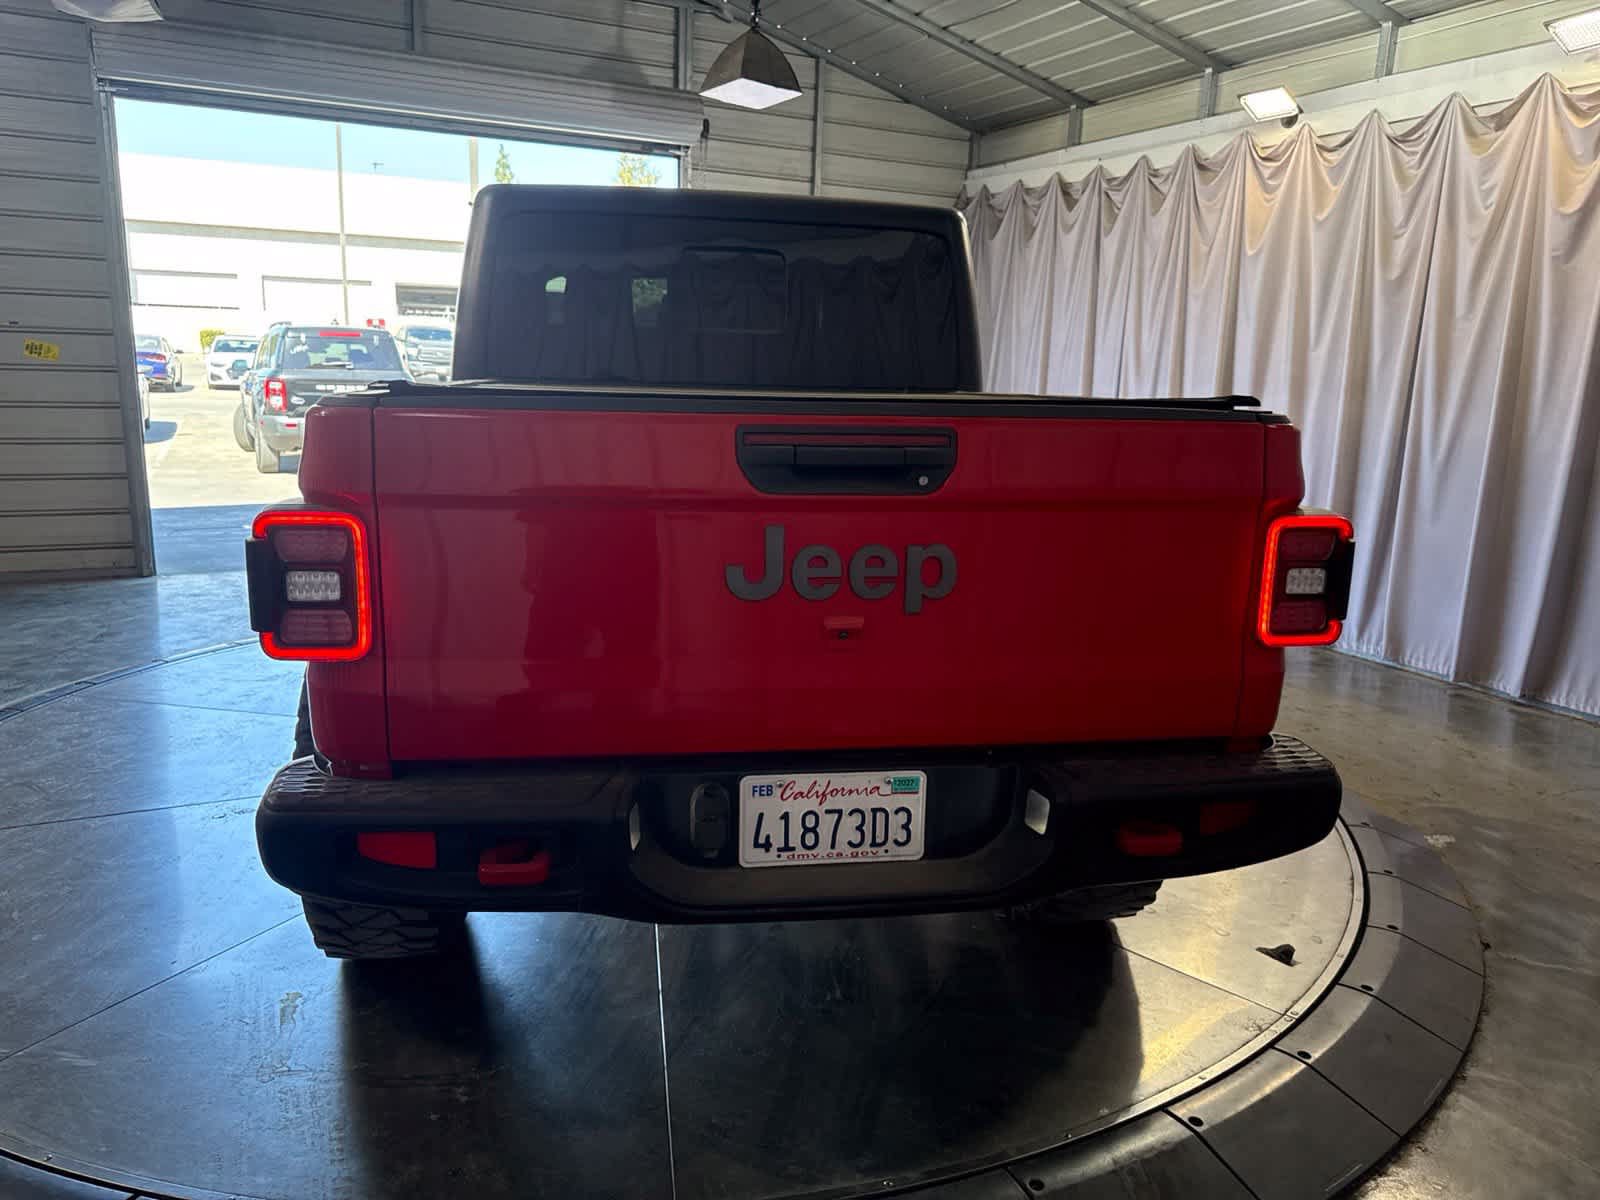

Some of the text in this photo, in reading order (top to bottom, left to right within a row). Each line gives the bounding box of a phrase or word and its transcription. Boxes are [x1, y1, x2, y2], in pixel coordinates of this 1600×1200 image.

[725, 524, 957, 615] Jeep
[752, 784, 774, 798] FEB
[780, 779, 891, 806] California
[752, 806, 913, 853] 41873D3
[786, 849, 880, 861] dmv.ca.gov
